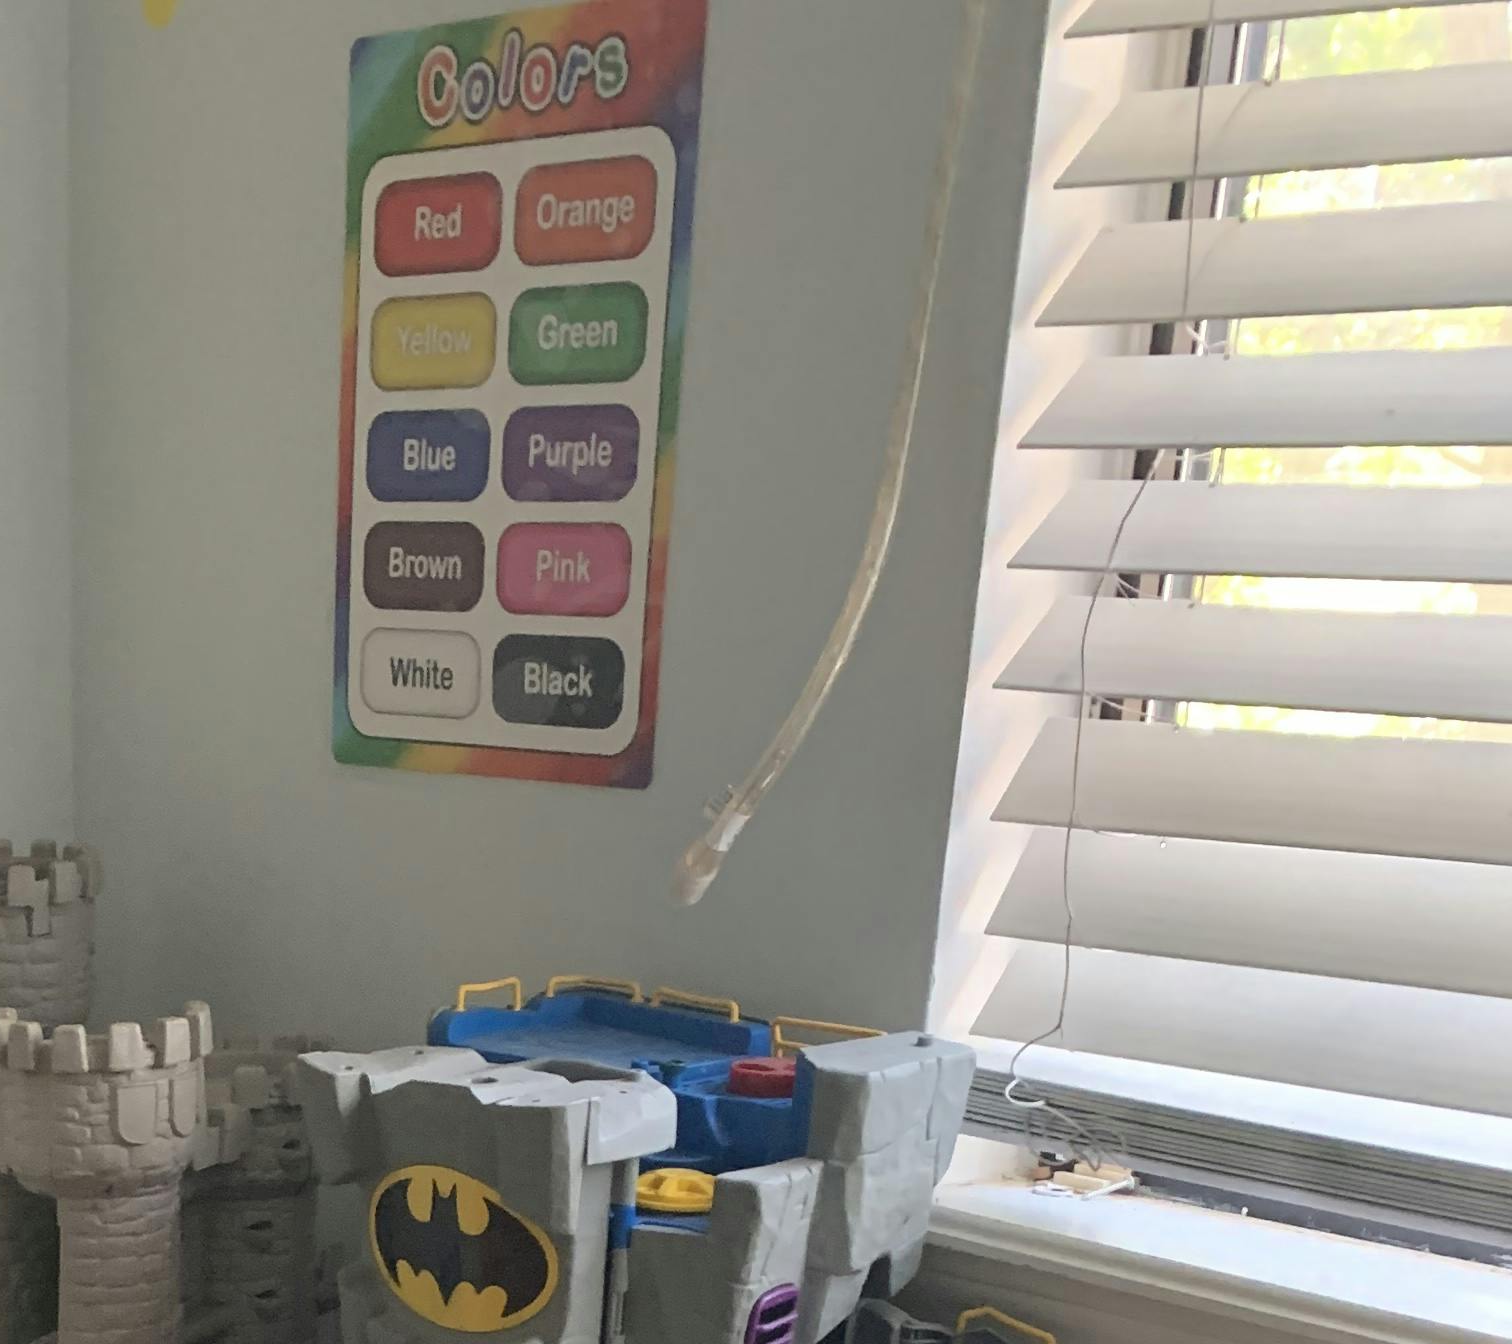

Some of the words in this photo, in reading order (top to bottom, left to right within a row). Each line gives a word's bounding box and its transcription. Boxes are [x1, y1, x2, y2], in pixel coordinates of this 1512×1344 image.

[418, 30, 628, 127] Colors
[414, 204, 462, 241] Red
[536, 191, 636, 232] Orange
[398, 324, 472, 357] Yellow
[538, 315, 618, 350] Green
[403, 438, 456, 472] Blue
[529, 433, 613, 475] Purple
[389, 547, 462, 581] Brown
[535, 548, 591, 582] Pink
[390, 657, 454, 691] White
[523, 661, 593, 698] Black
